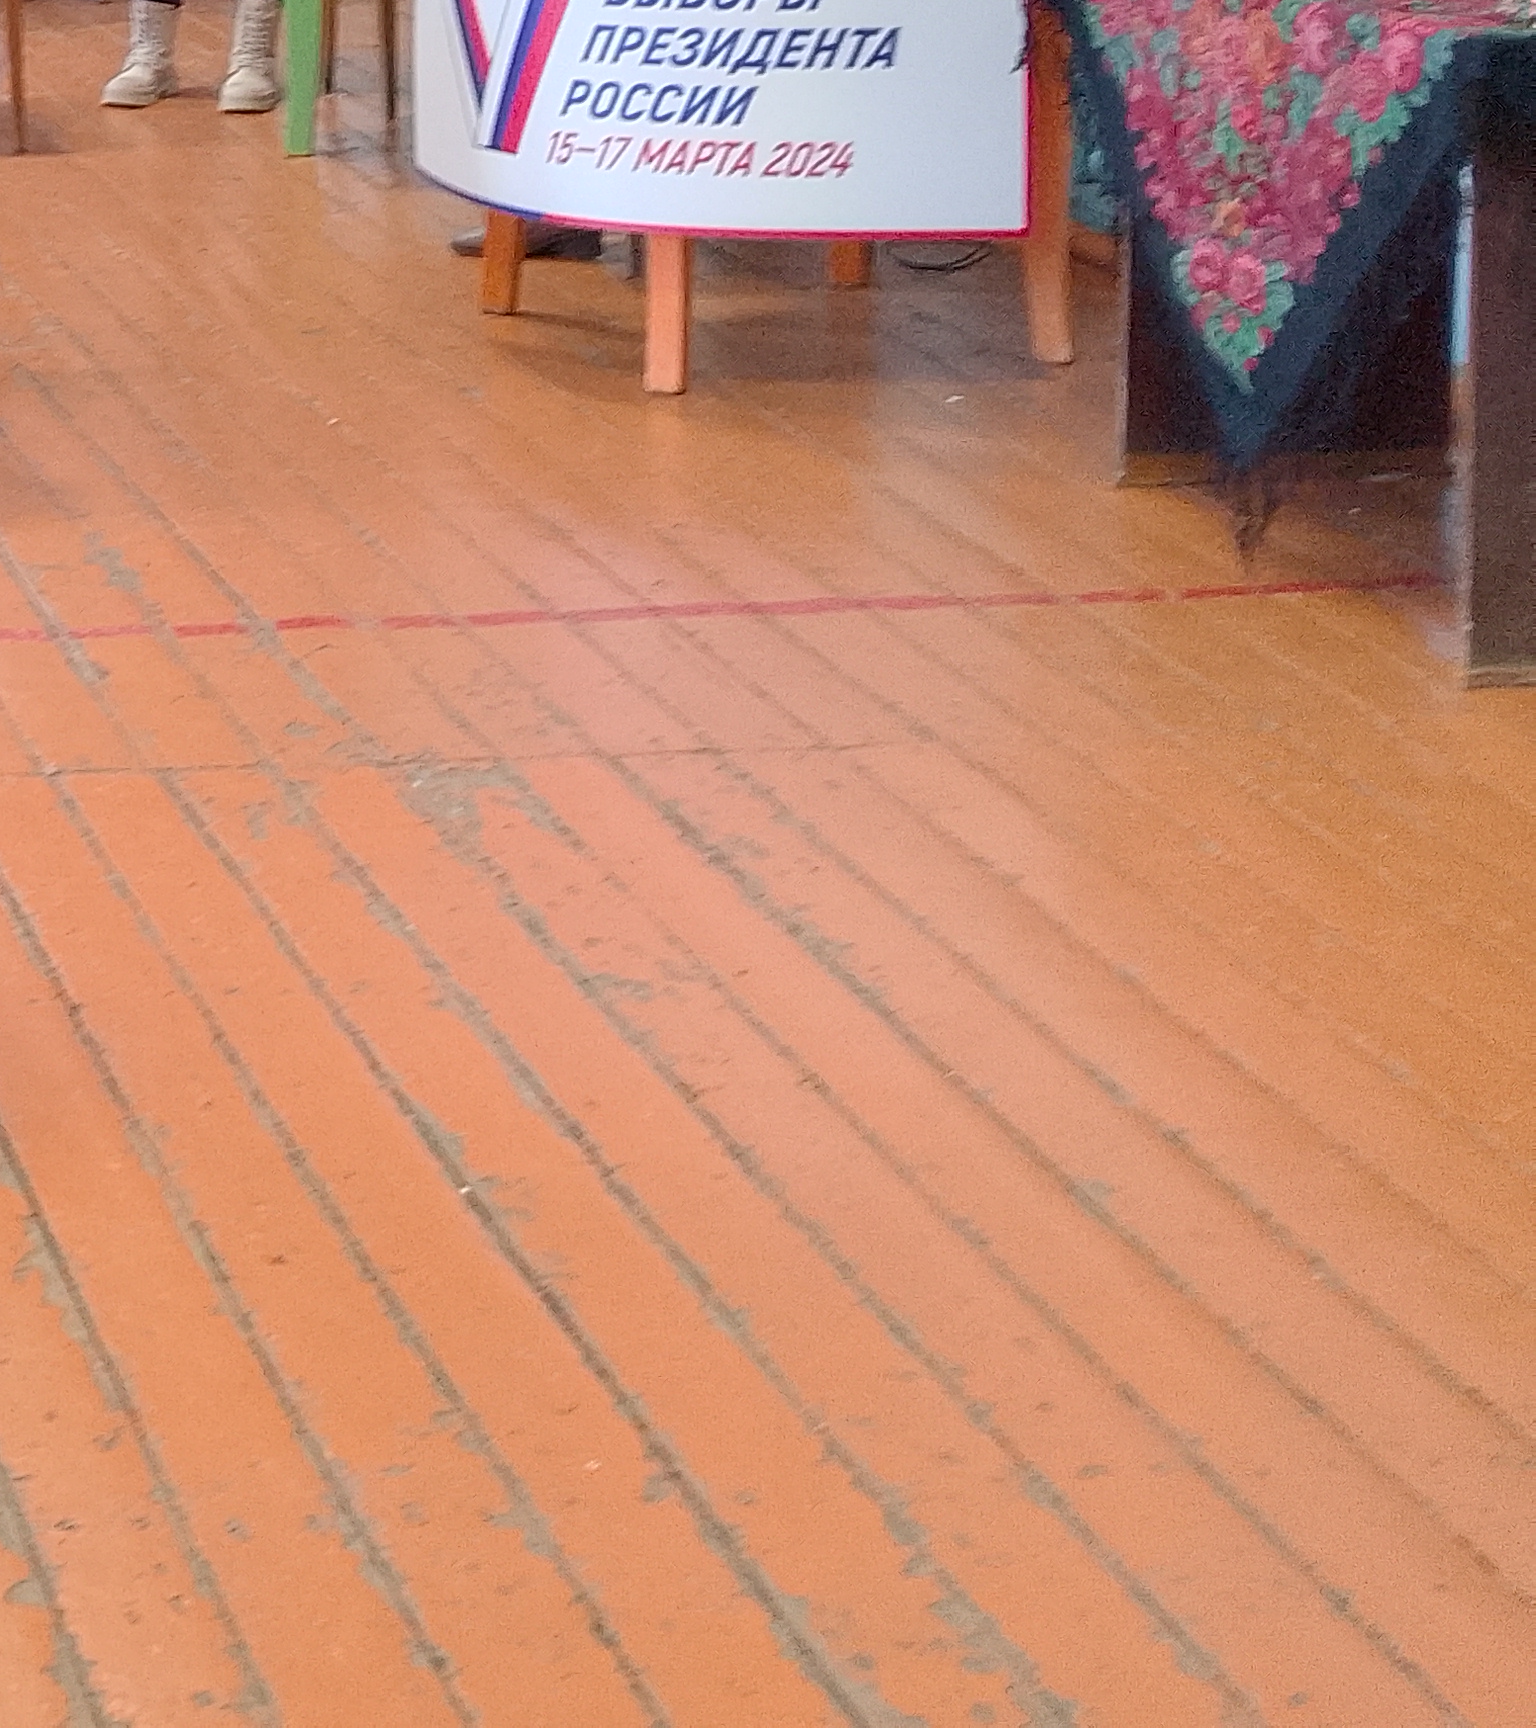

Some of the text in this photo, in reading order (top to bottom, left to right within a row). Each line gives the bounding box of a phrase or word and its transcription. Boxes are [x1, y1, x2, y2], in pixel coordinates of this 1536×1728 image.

[580, 24, 903, 76] ПРЕЗИДЕНТА
[559, 78, 760, 127] РОССИИ
[633, 137, 757, 177] МАРТА
[760, 140, 855, 178] 2024
